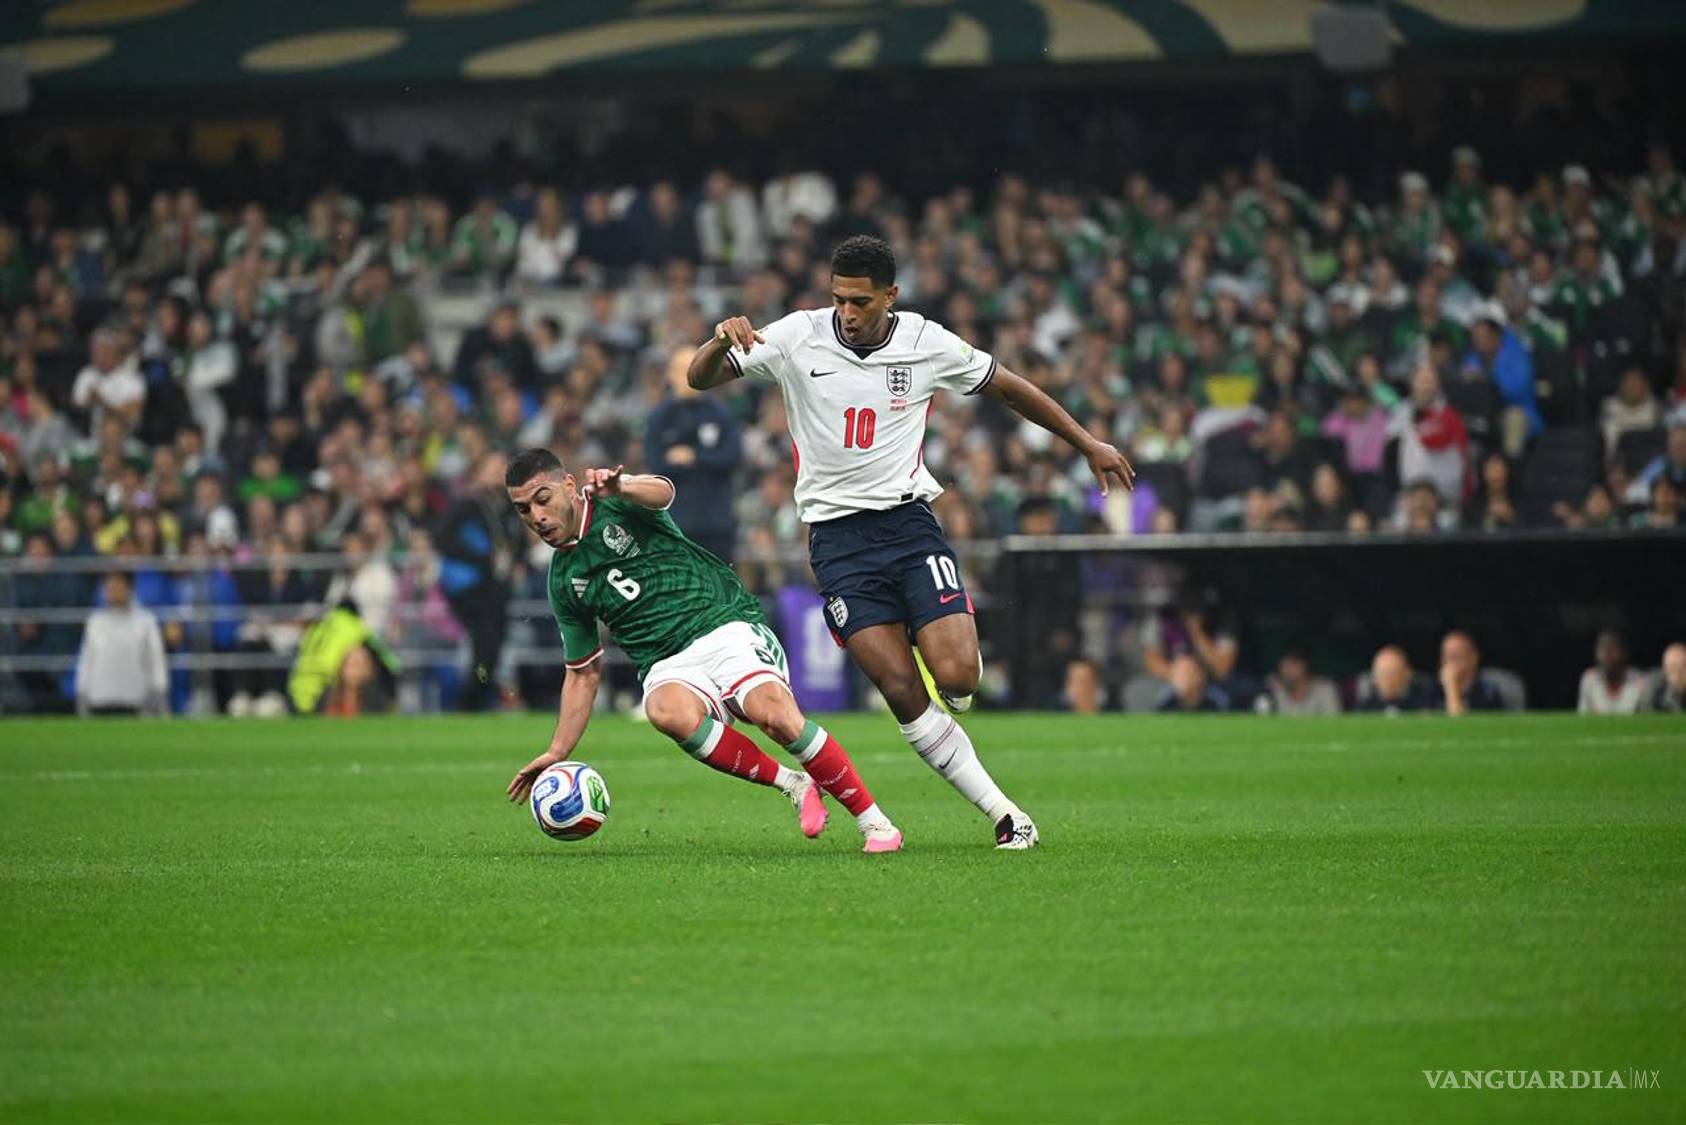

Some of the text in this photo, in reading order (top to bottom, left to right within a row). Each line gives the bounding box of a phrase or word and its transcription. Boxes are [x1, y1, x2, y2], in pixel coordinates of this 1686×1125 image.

[844, 407, 876, 449] 10
[607, 569, 640, 600] 6
[926, 555, 959, 590] 10
